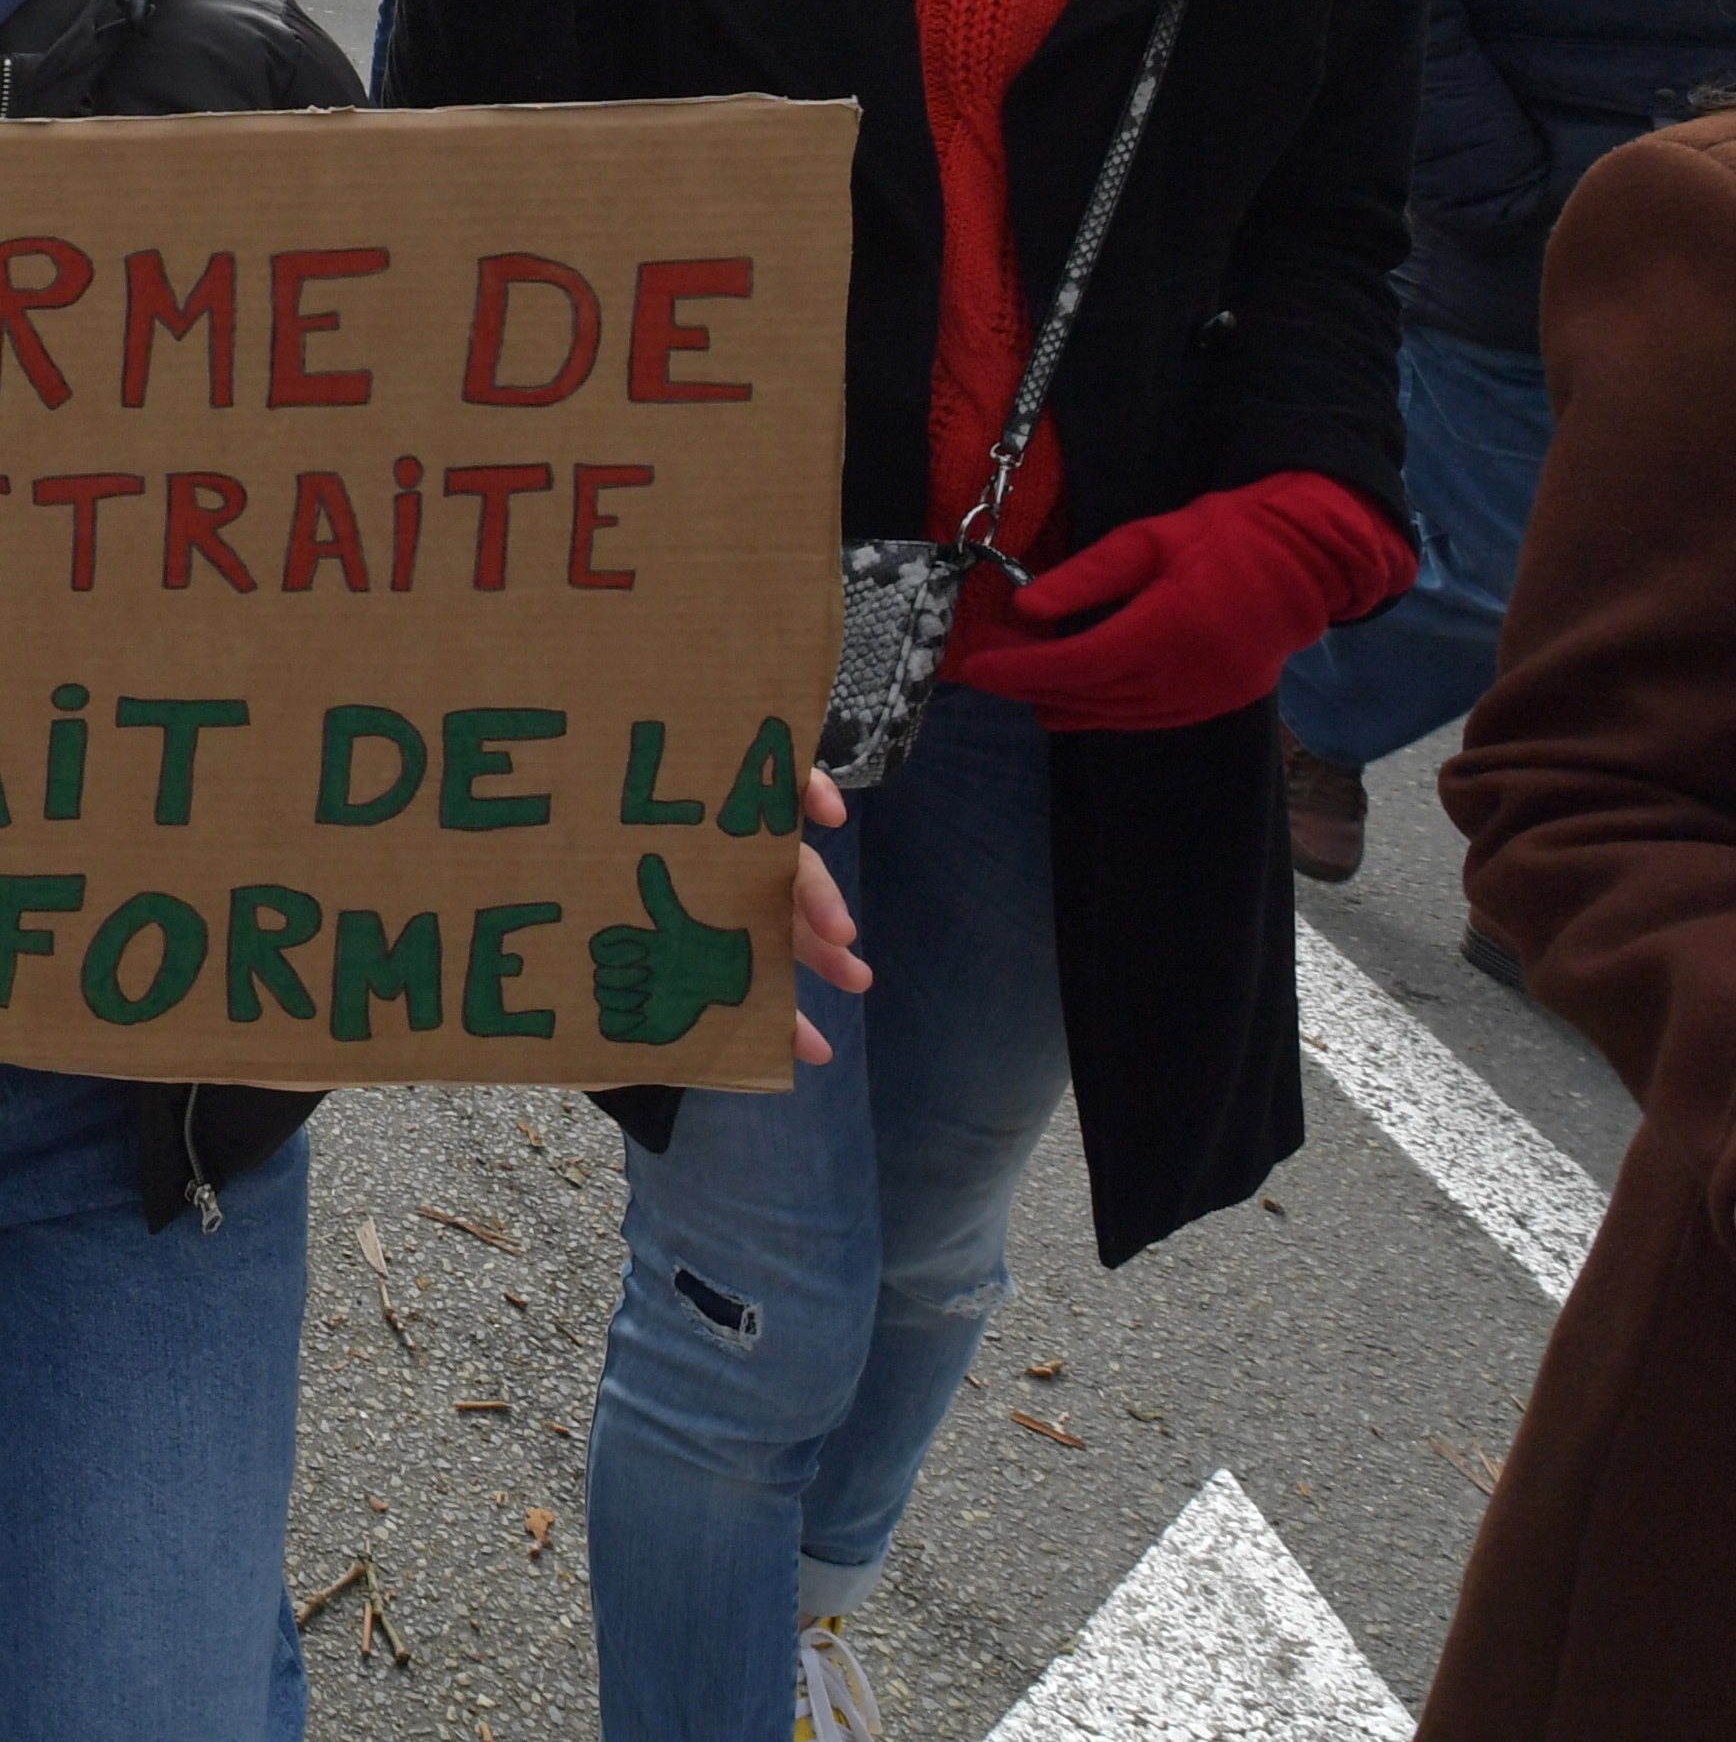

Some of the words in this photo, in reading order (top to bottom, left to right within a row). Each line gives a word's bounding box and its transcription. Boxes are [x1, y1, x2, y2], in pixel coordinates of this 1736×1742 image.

[462, 250, 754, 406] DE
[316, 705, 568, 831] DE
[620, 718, 800, 837] LA
